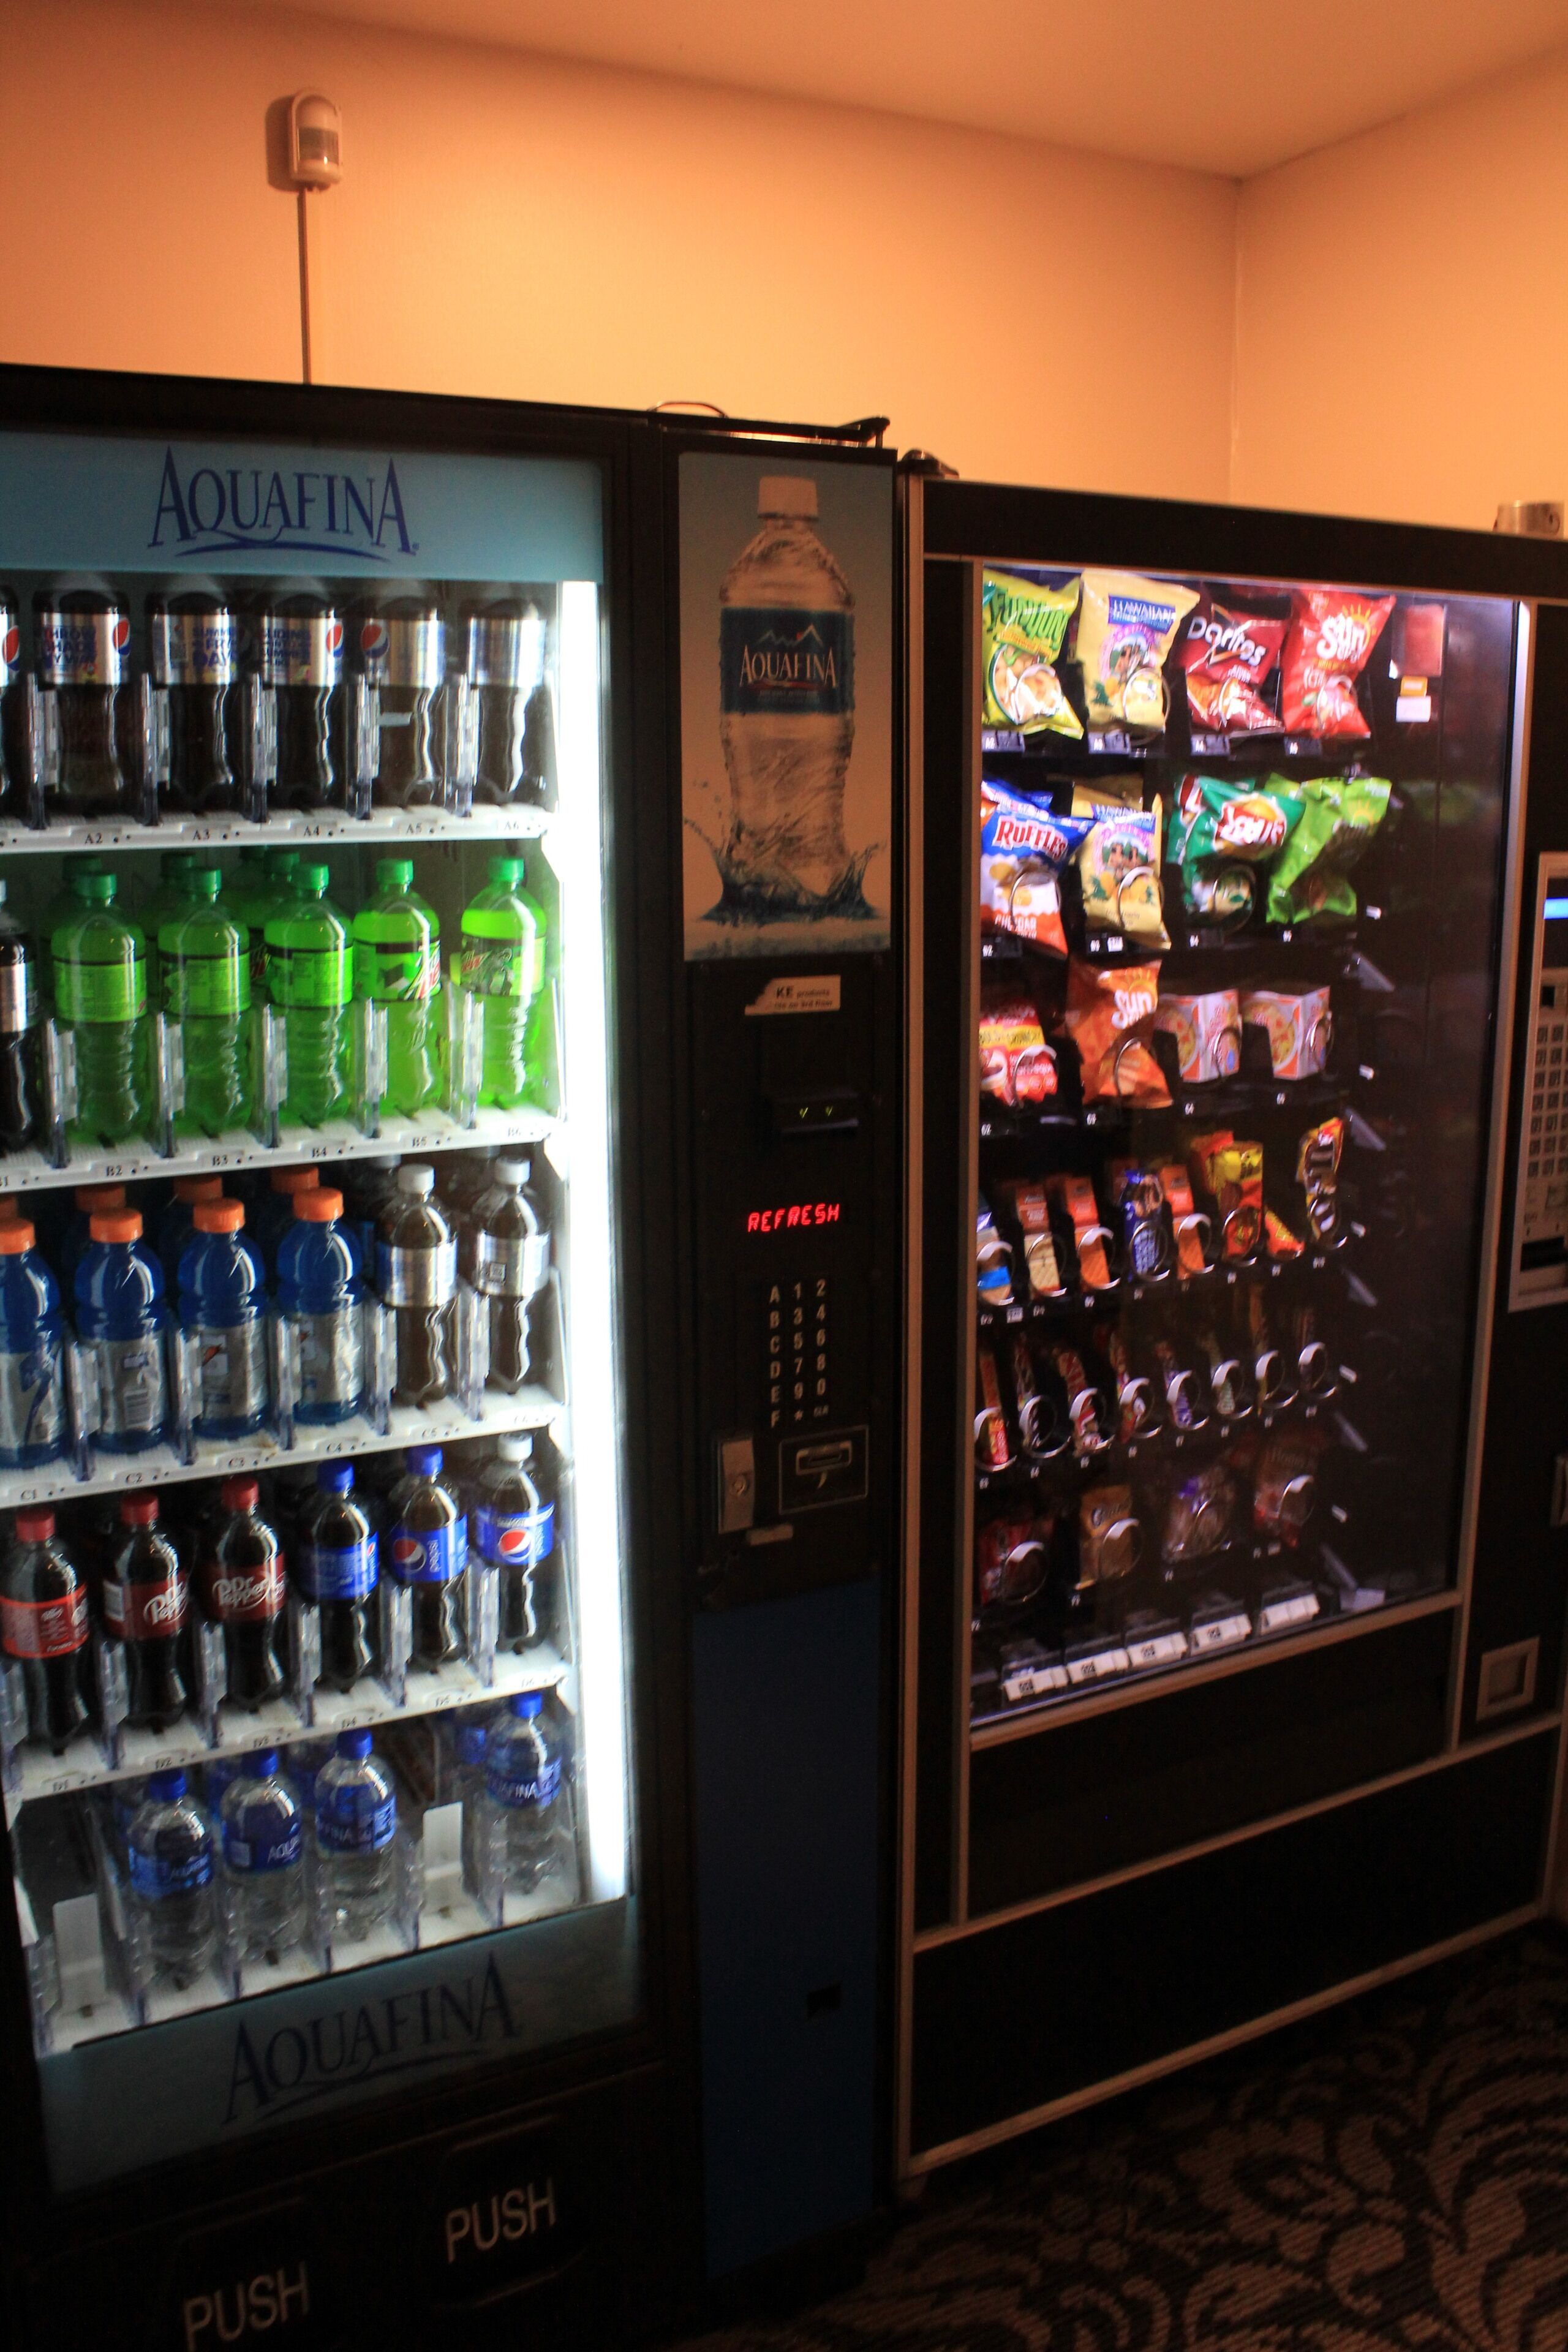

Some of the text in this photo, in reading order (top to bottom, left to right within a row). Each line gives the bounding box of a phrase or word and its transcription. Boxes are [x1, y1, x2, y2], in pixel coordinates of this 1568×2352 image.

[147, 445, 420, 559] AQUAFINA
[1186, 616, 1267, 667] Doritos
[739, 644, 839, 688] AQUAFINA
[85, 832, 104, 845] A2
[192, 829, 211, 841] A3
[303, 824, 320, 837] A4
[405, 823, 423, 835] A5
[1111, 990, 1156, 1030] Sun
[212, 1154, 228, 1167] B3
[311, 1145, 328, 1158] B4
[106, 1165, 123, 1177] B2
[747, 1202, 840, 1233] REFRESH
[769, 1284, 780, 1304] A
[793, 1281, 802, 1301] 1
[816, 1278, 827, 1297] 2
[769, 1310, 780, 1329] B
[816, 1303, 826, 1322] 4
[770, 1335, 780, 1354] C
[770, 1360, 781, 1380] D
[794, 1357, 804, 1376] 7
[771, 1384, 782, 1404] E
[816, 1377, 827, 1396] 0
[771, 1409, 781, 1429] F
[126, 1472, 143, 1485] C2
[21, 1488, 37, 1501] C1
[221, 1950, 522, 2128] AQUAFINA
[445, 2177, 557, 2264] PUSH
[183, 2260, 311, 2351] PUSH
